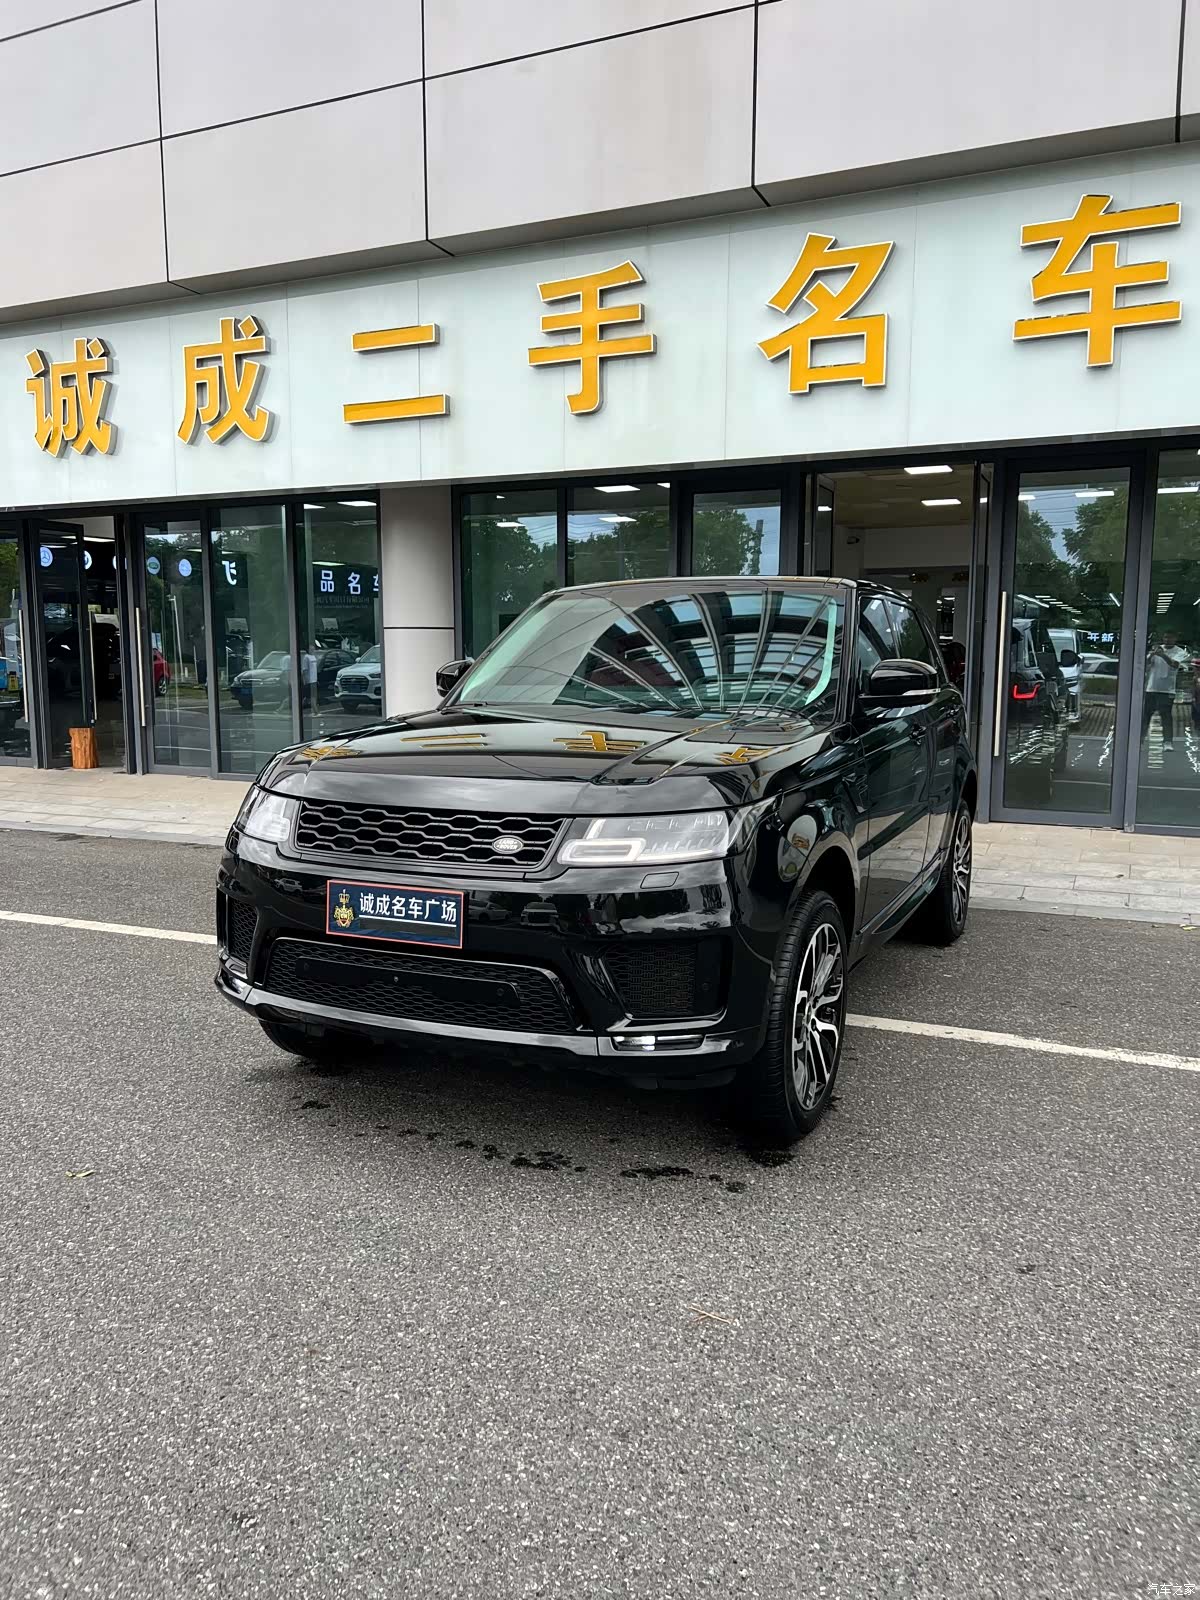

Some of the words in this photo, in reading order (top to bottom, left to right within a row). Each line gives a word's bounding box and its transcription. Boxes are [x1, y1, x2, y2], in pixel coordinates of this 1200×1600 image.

[25, 194, 1182, 458] 诚成二手名车
[359, 892, 457, 923] 诚成名车广场
